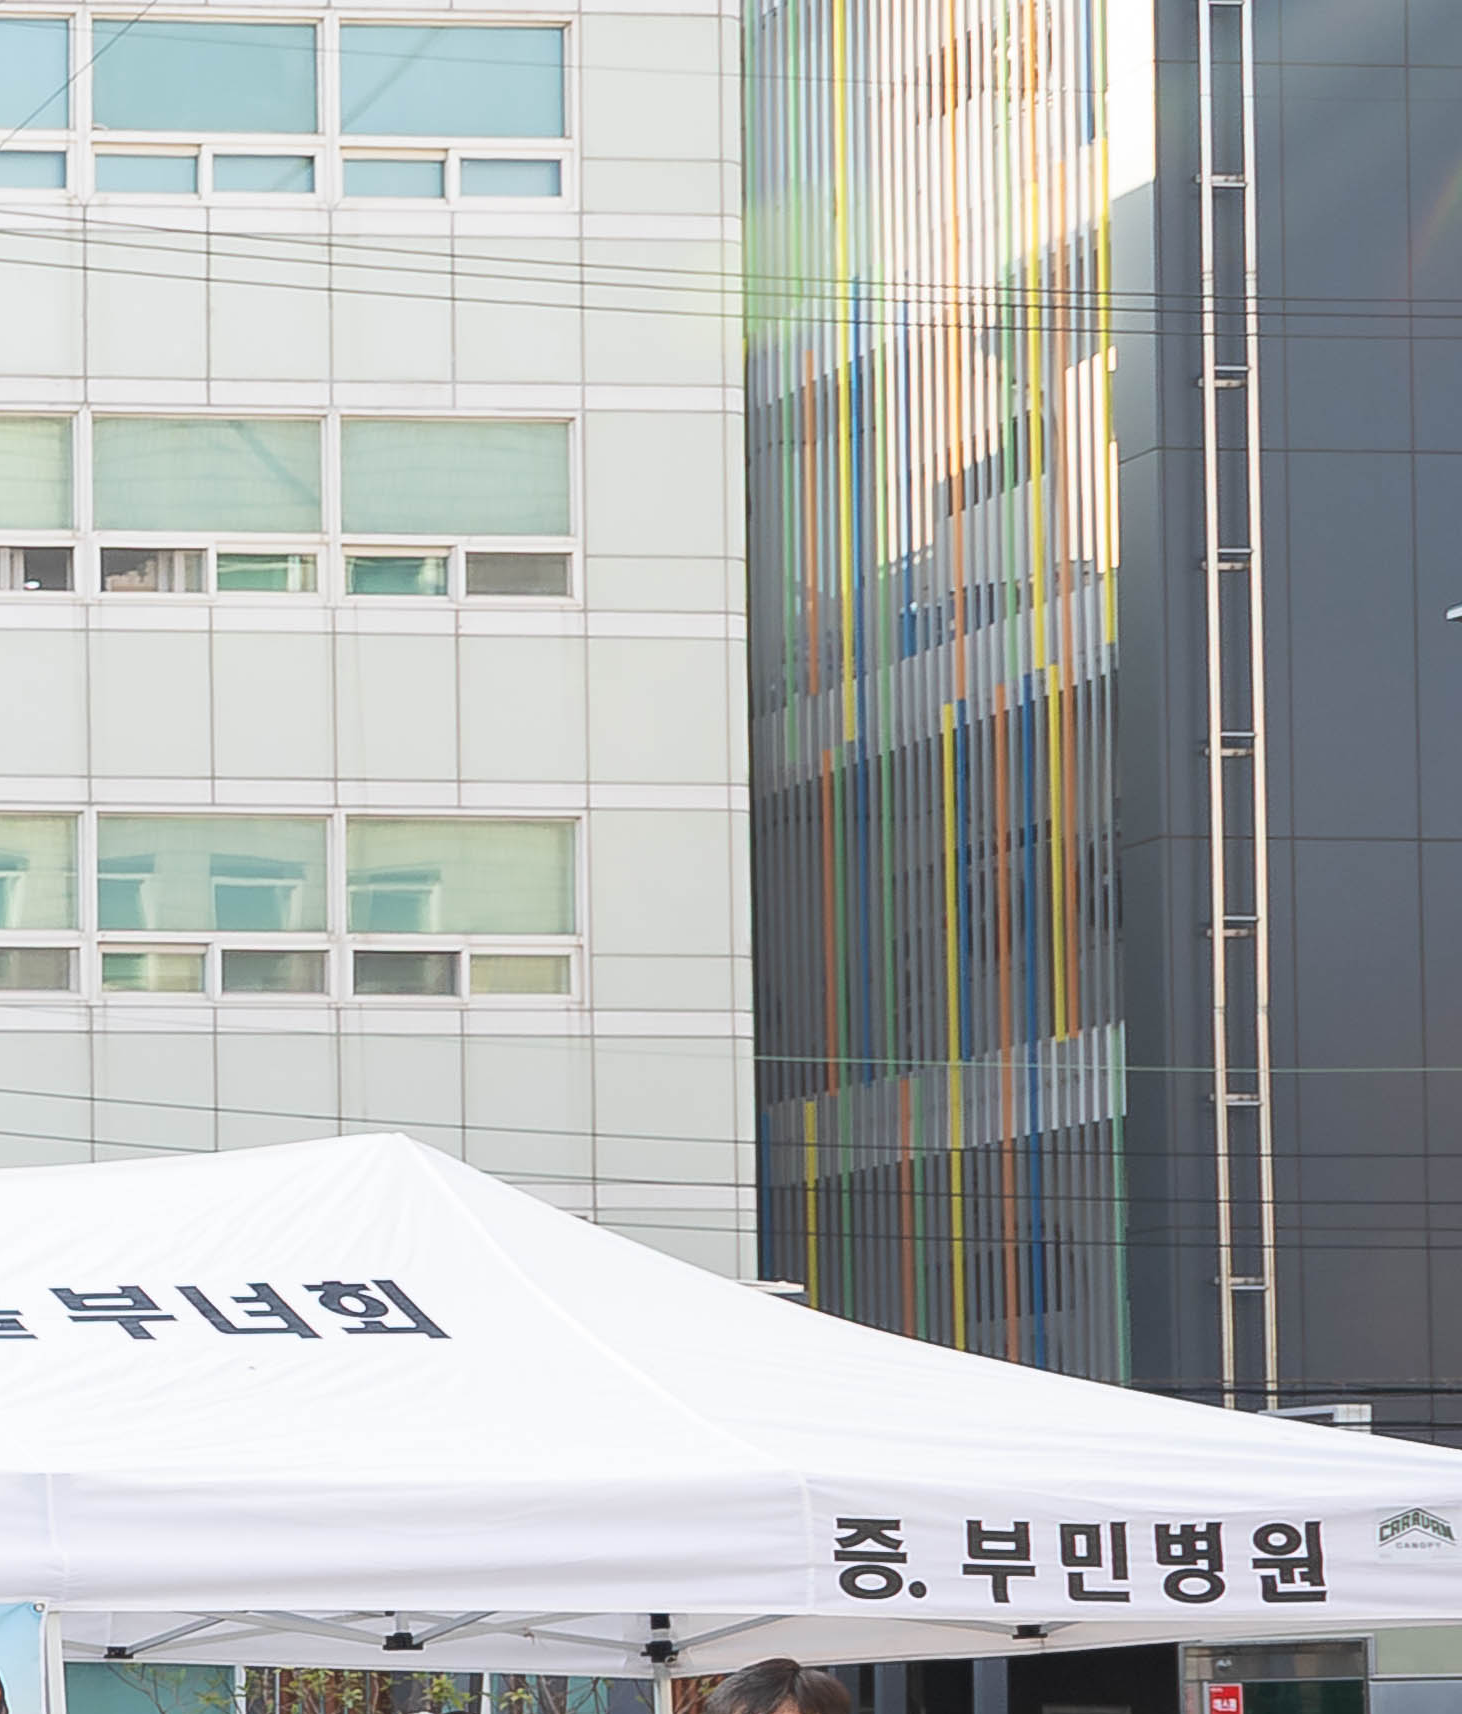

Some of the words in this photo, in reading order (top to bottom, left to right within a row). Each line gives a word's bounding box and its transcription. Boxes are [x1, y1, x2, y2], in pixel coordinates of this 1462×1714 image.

[833, 1515, 928, 1601] 증.
[961, 1518, 1330, 1604] 부민병원
[1394, 1540, 1444, 1551] CANOPY
